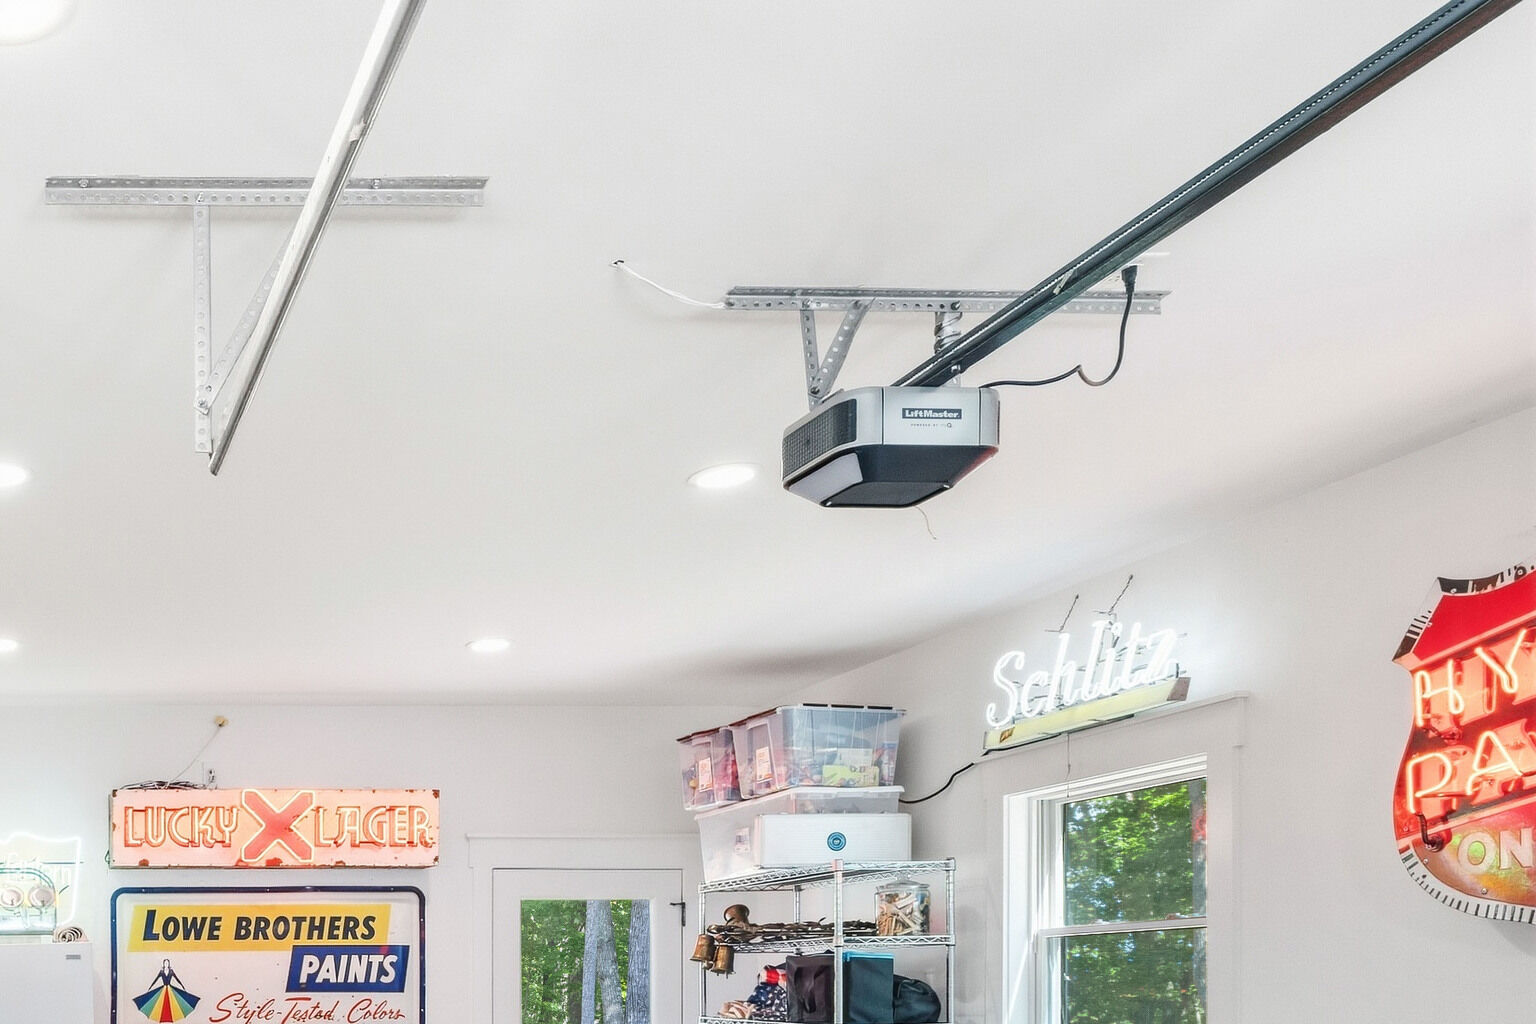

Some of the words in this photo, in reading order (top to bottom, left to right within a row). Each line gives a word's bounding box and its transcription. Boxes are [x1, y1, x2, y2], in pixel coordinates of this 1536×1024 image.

[905, 409, 959, 418] LiftMaster
[986, 619, 1178, 728] Schlitz
[124, 806, 239, 848] LUCKY
[315, 806, 436, 848] LAGER
[142, 909, 223, 942] LOWE
[233, 915, 377, 941] BROTHERS
[298, 954, 399, 985] PAINTS
[347, 998, 406, 1024] Colors
